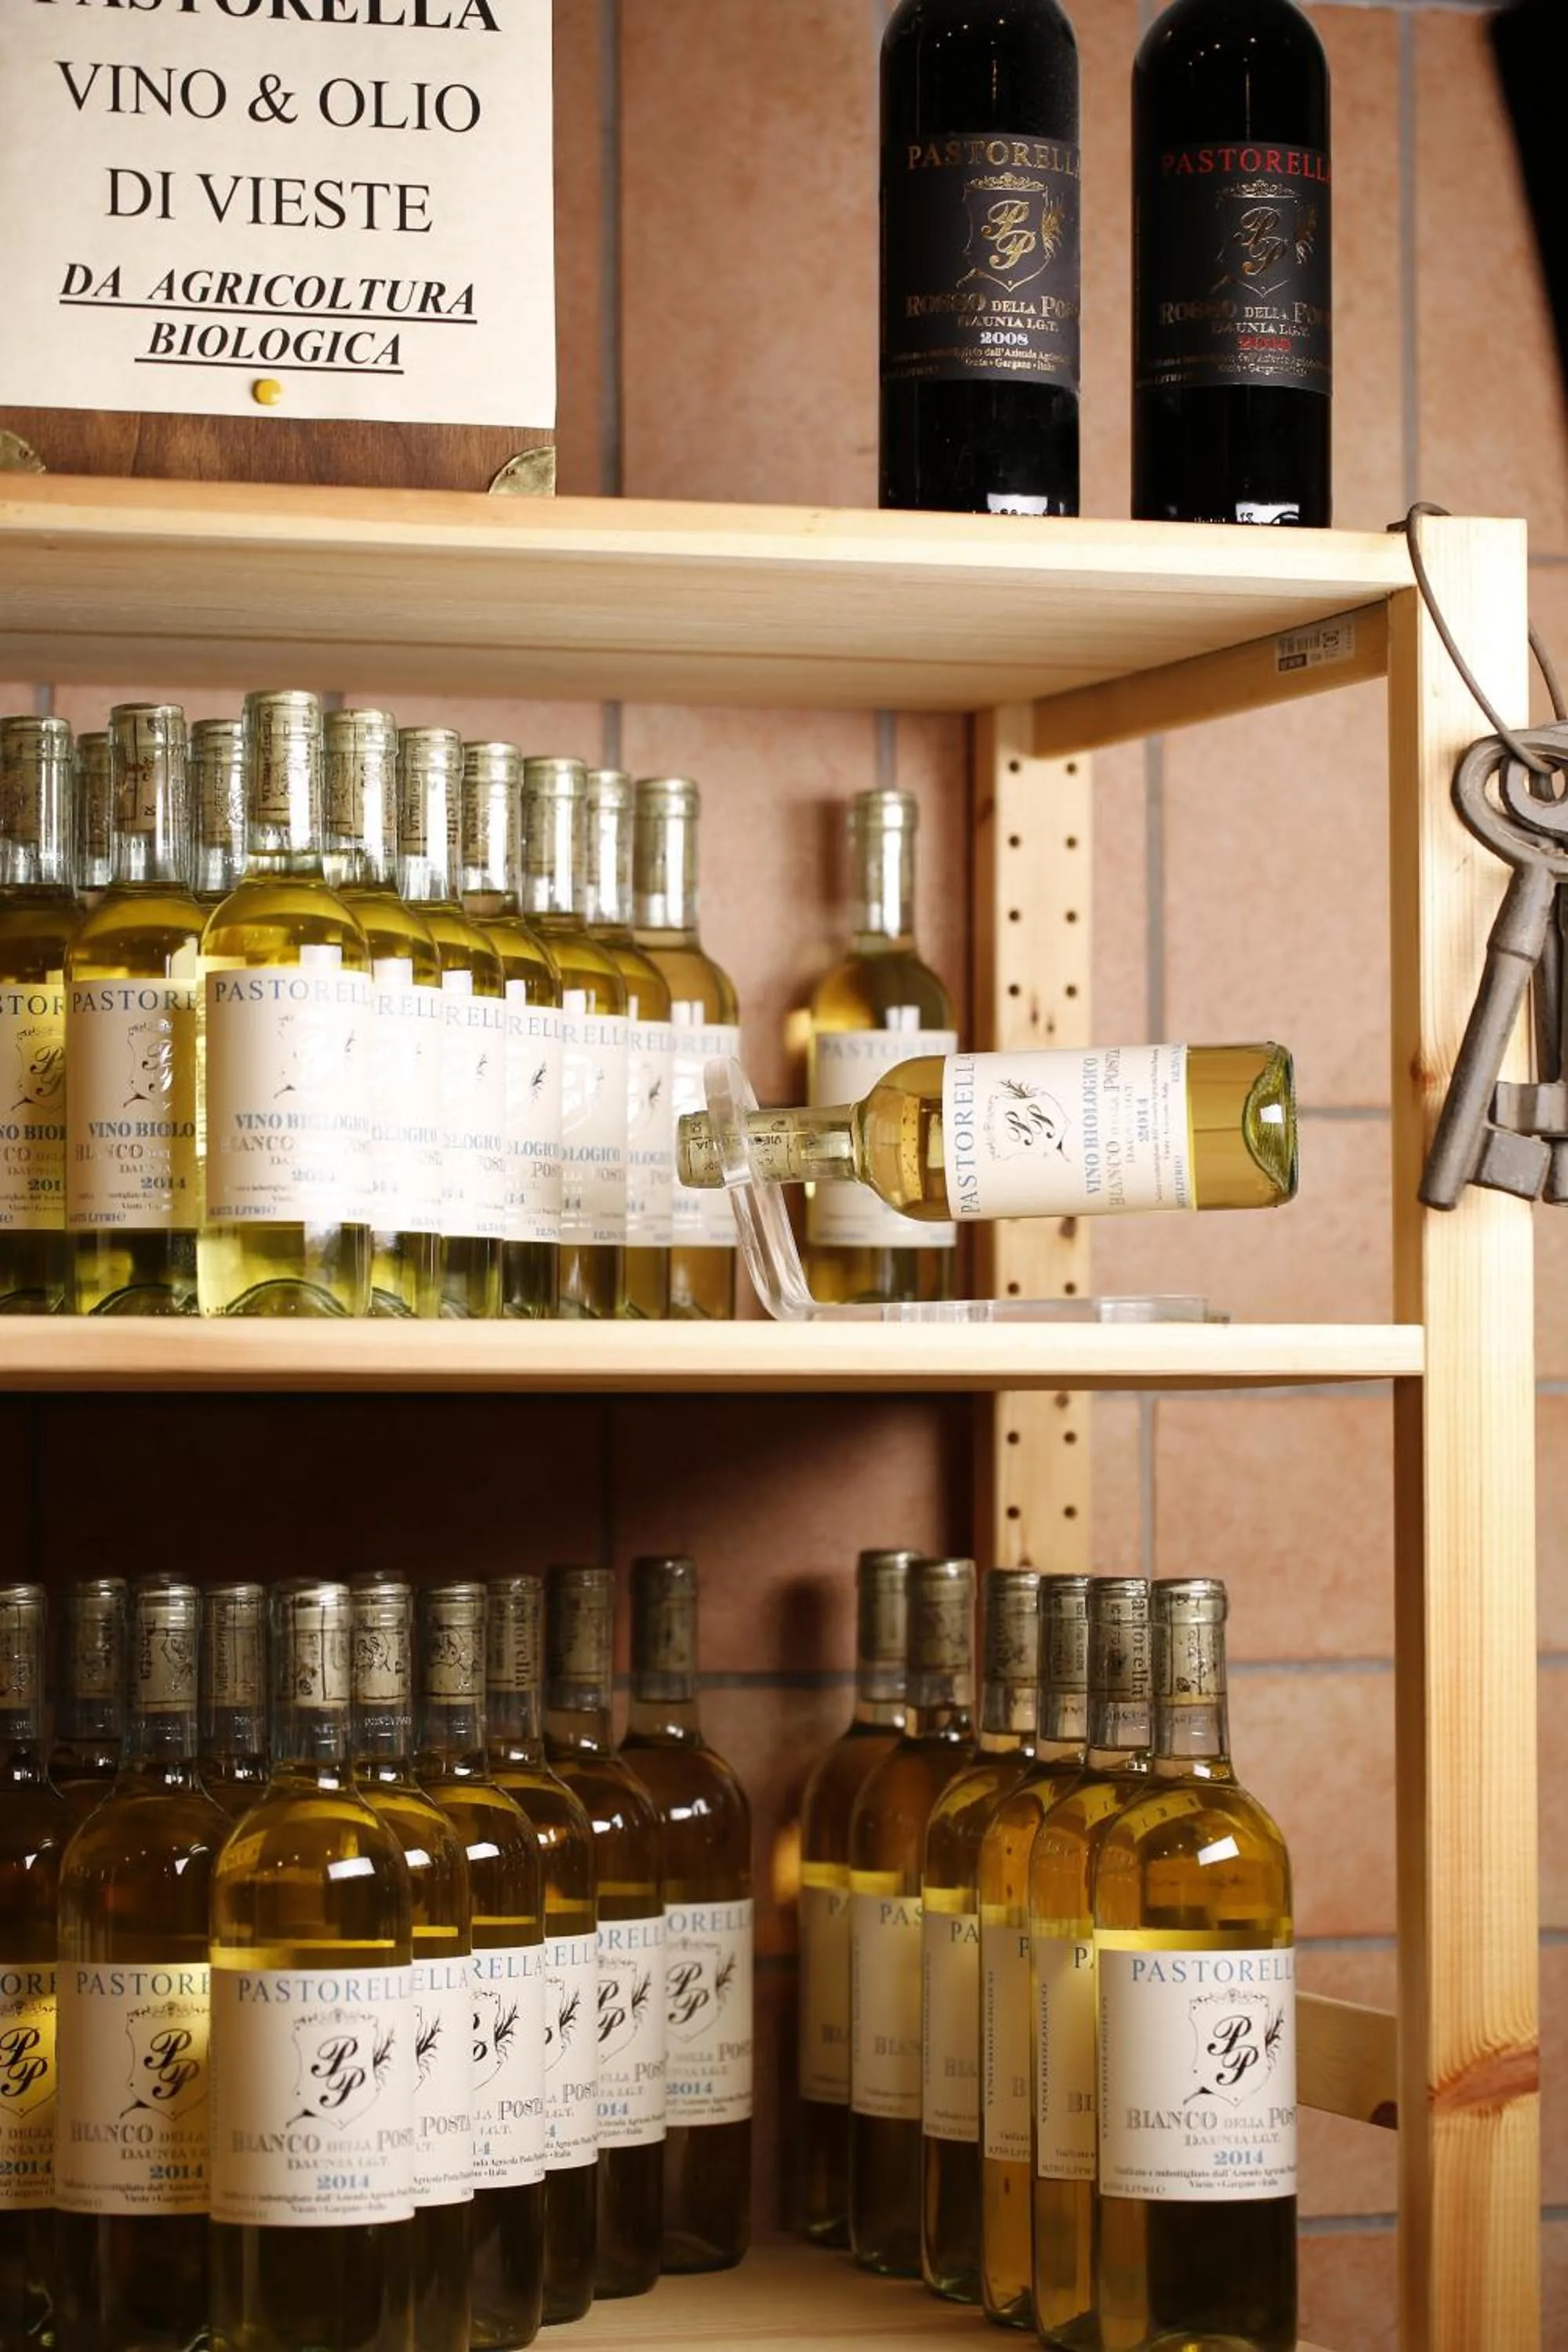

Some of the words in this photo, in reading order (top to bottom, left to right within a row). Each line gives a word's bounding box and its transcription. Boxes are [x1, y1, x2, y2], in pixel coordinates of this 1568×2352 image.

[55, 60, 227, 119] VINO
[248, 74, 299, 124] &
[319, 78, 481, 133] OLIO
[106, 166, 176, 220] DI
[195, 172, 434, 233] VIESTE
[60, 263, 122, 298] DA
[147, 267, 477, 317] AGRICOLTURA
[991, 299, 1037, 314] DELLA
[147, 321, 403, 366] BIOLOGICA
[979, 332, 1029, 346] 2008
[0, 995, 64, 1015] TOR
[88, 1122, 132, 1138] VINO
[234, 1113, 283, 1130] VINO
[220, 1135, 296, 1152] ANCO
[1126, 2106, 1218, 2131] BIANCO
[1213, 2149, 1265, 2167] 2014
[149, 2163, 203, 2180] 2014
[316, 2173, 370, 2190] 2014
